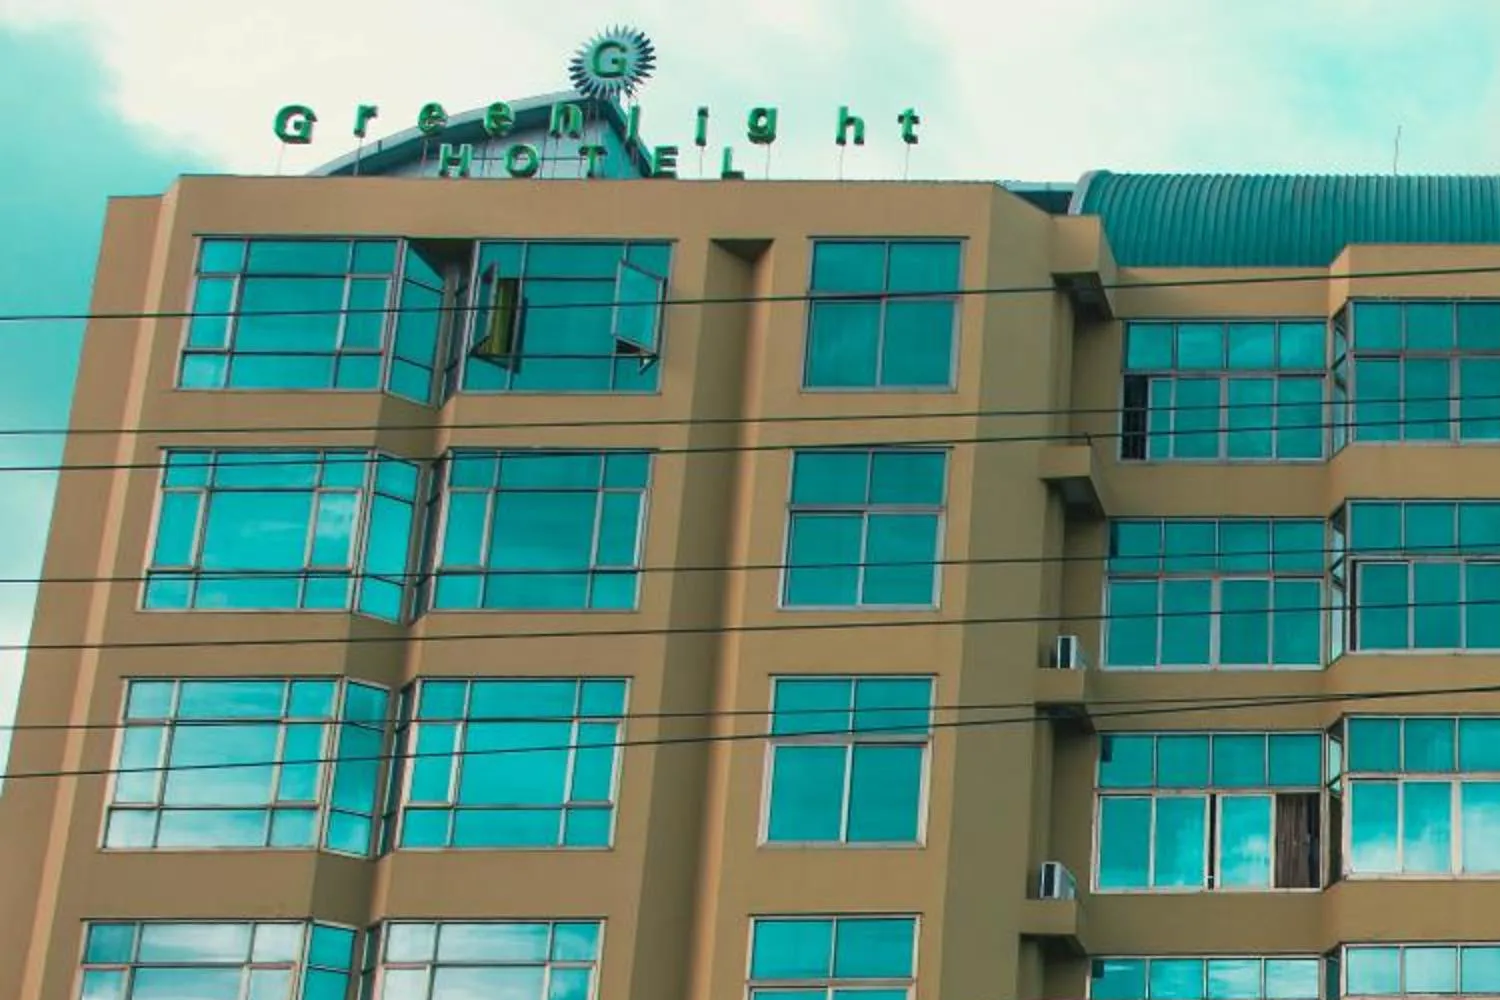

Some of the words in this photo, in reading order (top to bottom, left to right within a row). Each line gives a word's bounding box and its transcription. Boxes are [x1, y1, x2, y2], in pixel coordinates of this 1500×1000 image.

[592, 41, 628, 78] G
[273, 102, 920, 145] Greenlight
[438, 143, 745, 180] HOTEL
